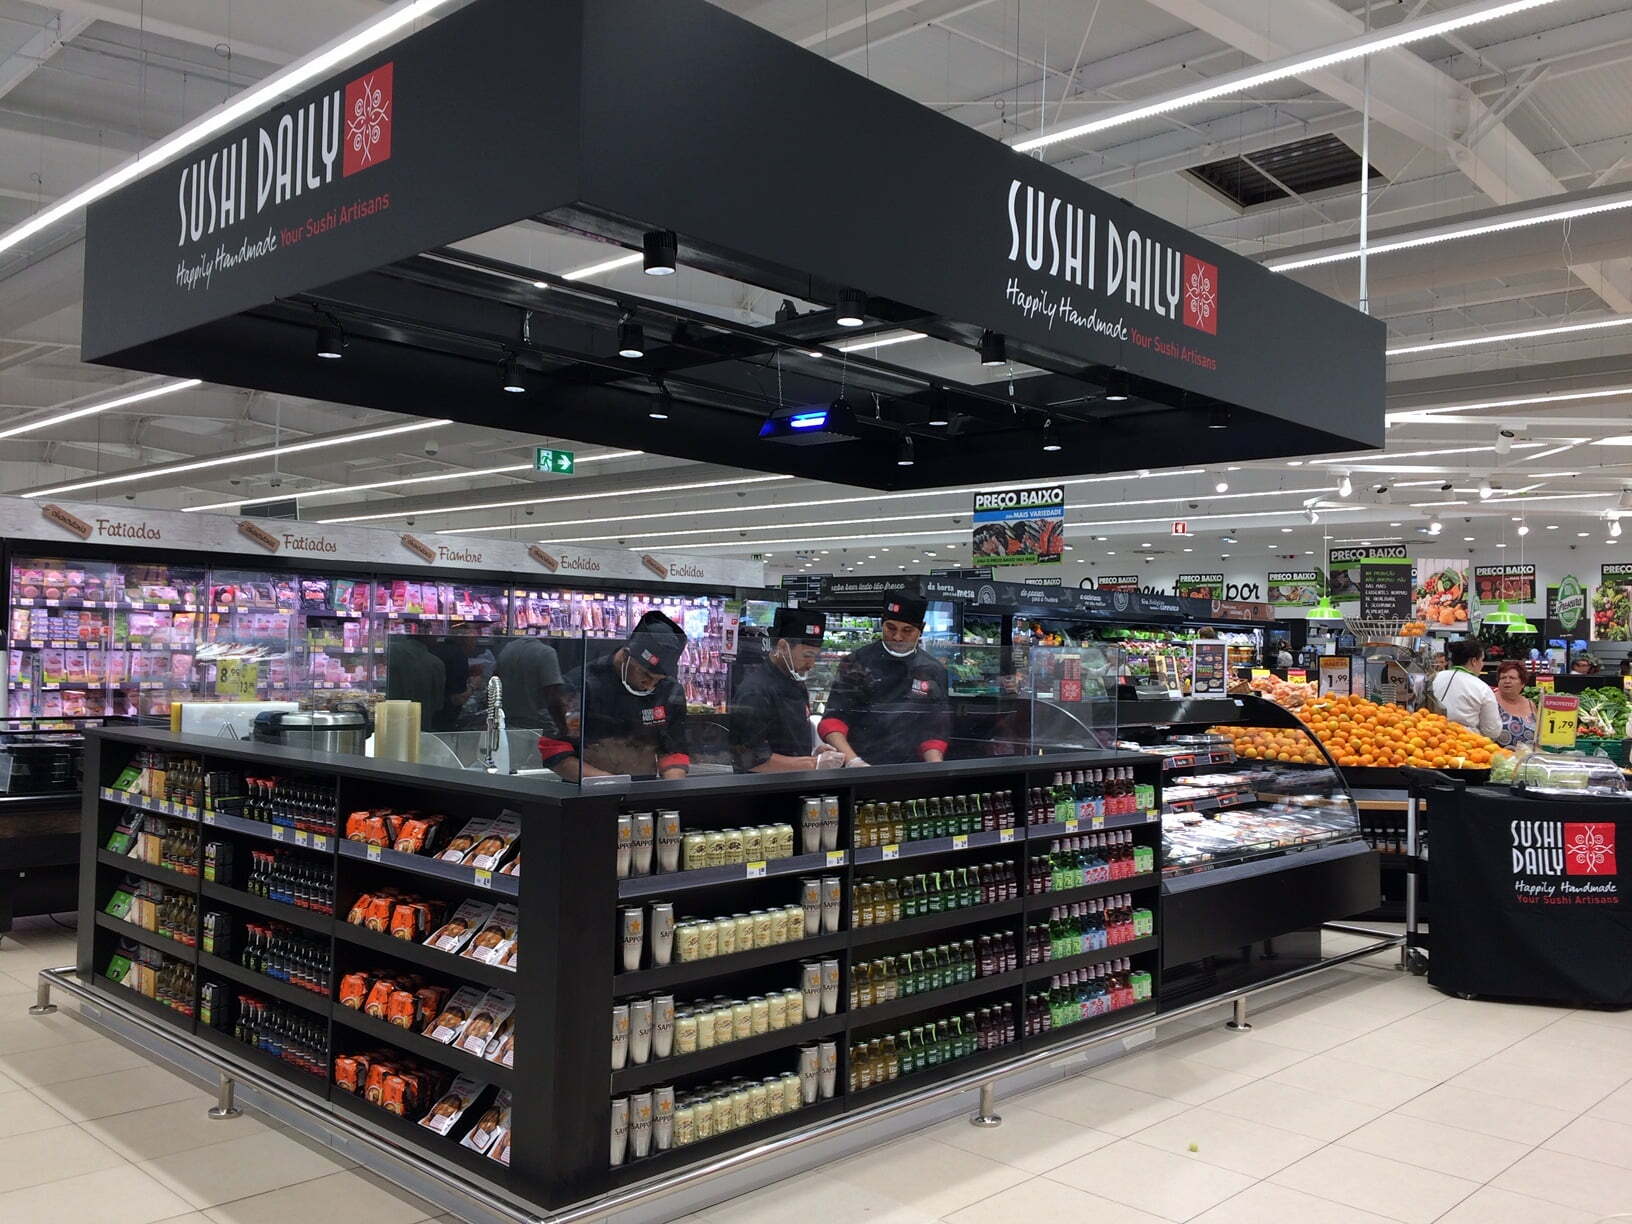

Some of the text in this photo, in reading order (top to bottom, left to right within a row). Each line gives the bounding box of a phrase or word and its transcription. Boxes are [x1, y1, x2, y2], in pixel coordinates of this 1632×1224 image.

[178, 89, 341, 247] SUSHI DAILY
[280, 192, 391, 248] Your Sushi Artisans
[175, 226, 278, 291] Happily Handmade
[1008, 179, 1181, 320] SUSHI DAILY
[1006, 277, 1128, 341] Happily Handmade
[1130, 327, 1217, 372] Your Sushi Artisans
[975, 487, 1064, 511] PREÇO BAIXO
[1014, 510, 1029, 519] MAIS
[1030, 508, 1063, 518] VARIEDADE
[95, 518, 161, 540] Fatiados
[281, 533, 337, 553] Fatiados
[437, 545, 483, 563] Fiambre
[1331, 546, 1406, 561] PREÇO BAIXO
[560, 554, 601, 572] Enchidos
[668, 563, 705, 579] Enchidos
[1476, 565, 1535, 577] PREÇO BAIXO
[1603, 565, 1632, 575] PREÇO
[1098, 577, 1118, 585] PREÇO
[1118, 576, 1138, 584] BAIXO
[1180, 574, 1223, 584] PREÇO BAIXO
[1270, 572, 1316, 582] PREÇO BAIXO
[1225, 583, 1260, 601] por
[1511, 820, 1563, 848] SUSHI
[1512, 847, 1564, 876] DAILY
[1515, 880, 1617, 898] Happily Handmade
[1517, 895, 1619, 905] Your Sushi Artisans
